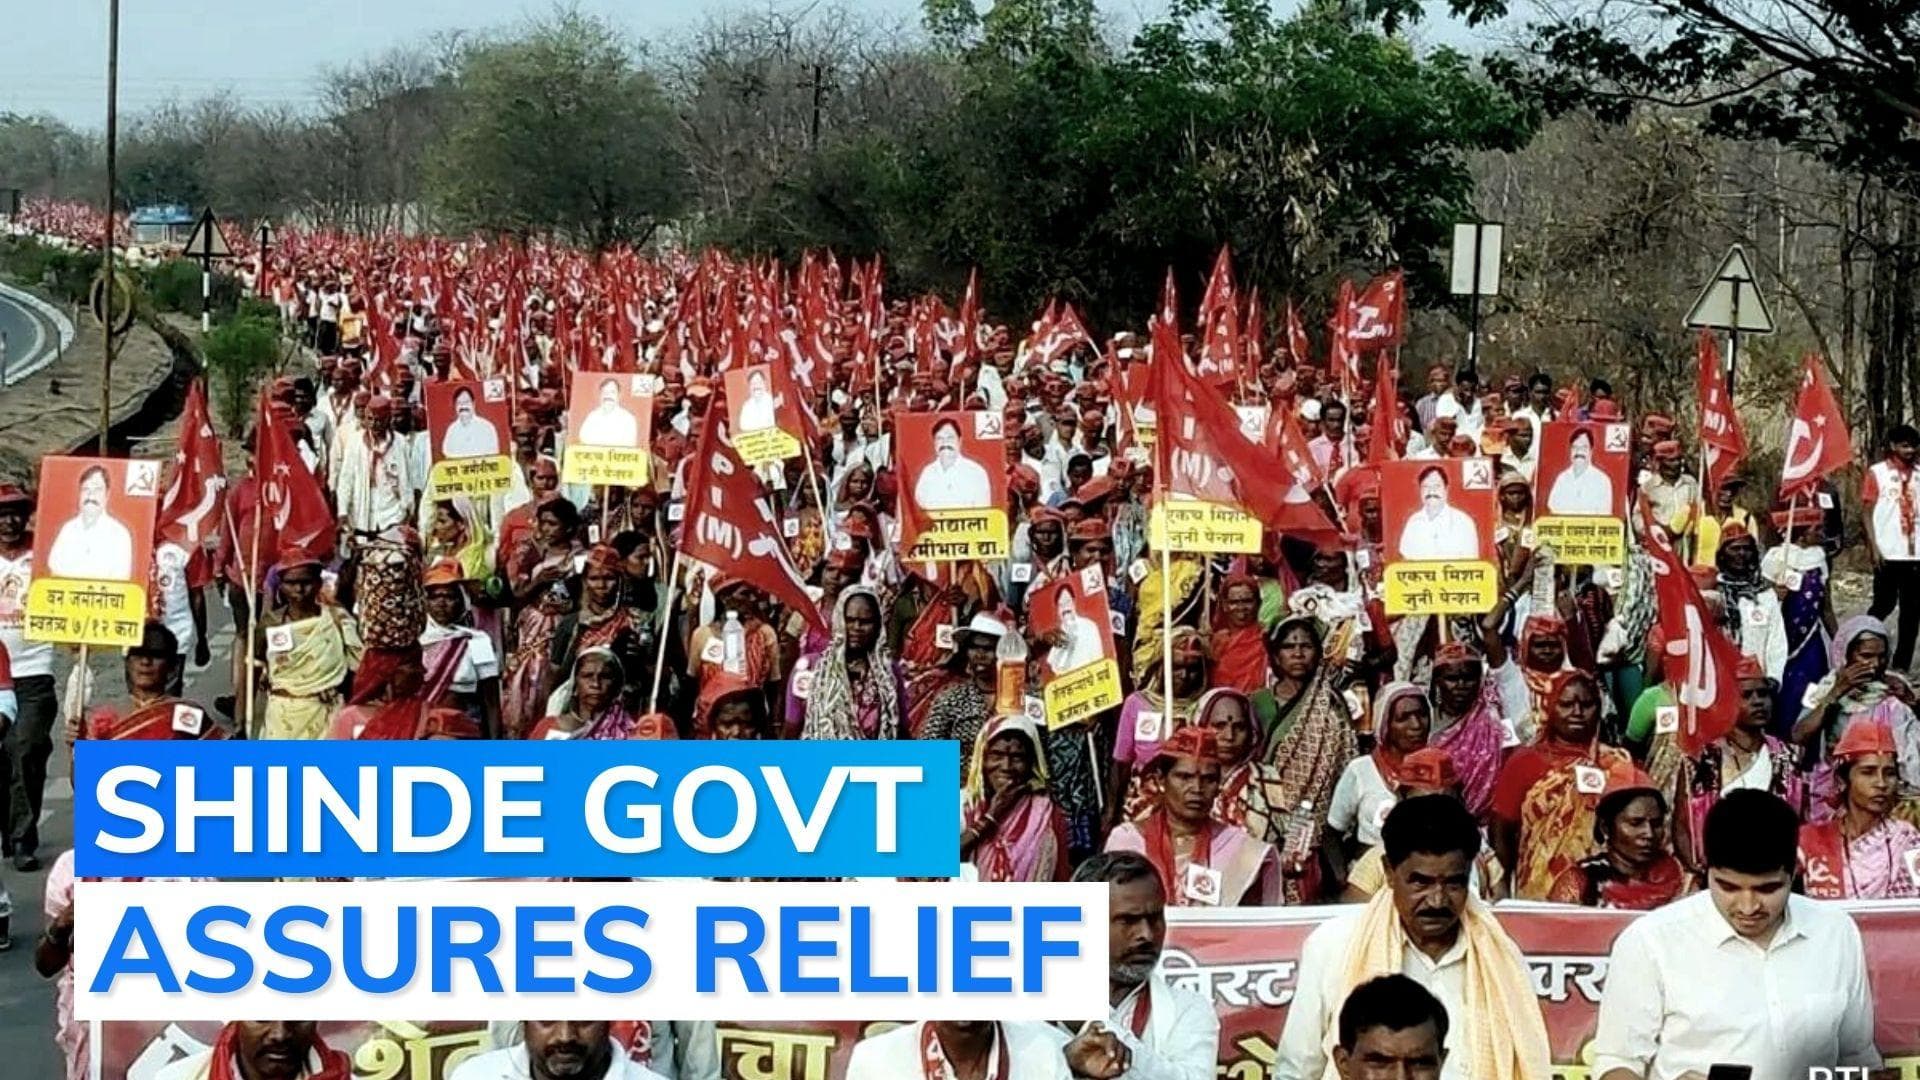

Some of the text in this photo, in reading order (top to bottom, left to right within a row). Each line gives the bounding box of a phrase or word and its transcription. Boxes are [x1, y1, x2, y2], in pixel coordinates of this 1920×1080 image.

[1170, 446, 1212, 489] (M)
[696, 511, 743, 561] (M)
[1396, 564, 1484, 587] एकच मिशन
[46, 589, 64, 606] वन
[1402, 587, 1480, 611] जुनी पेन्शन
